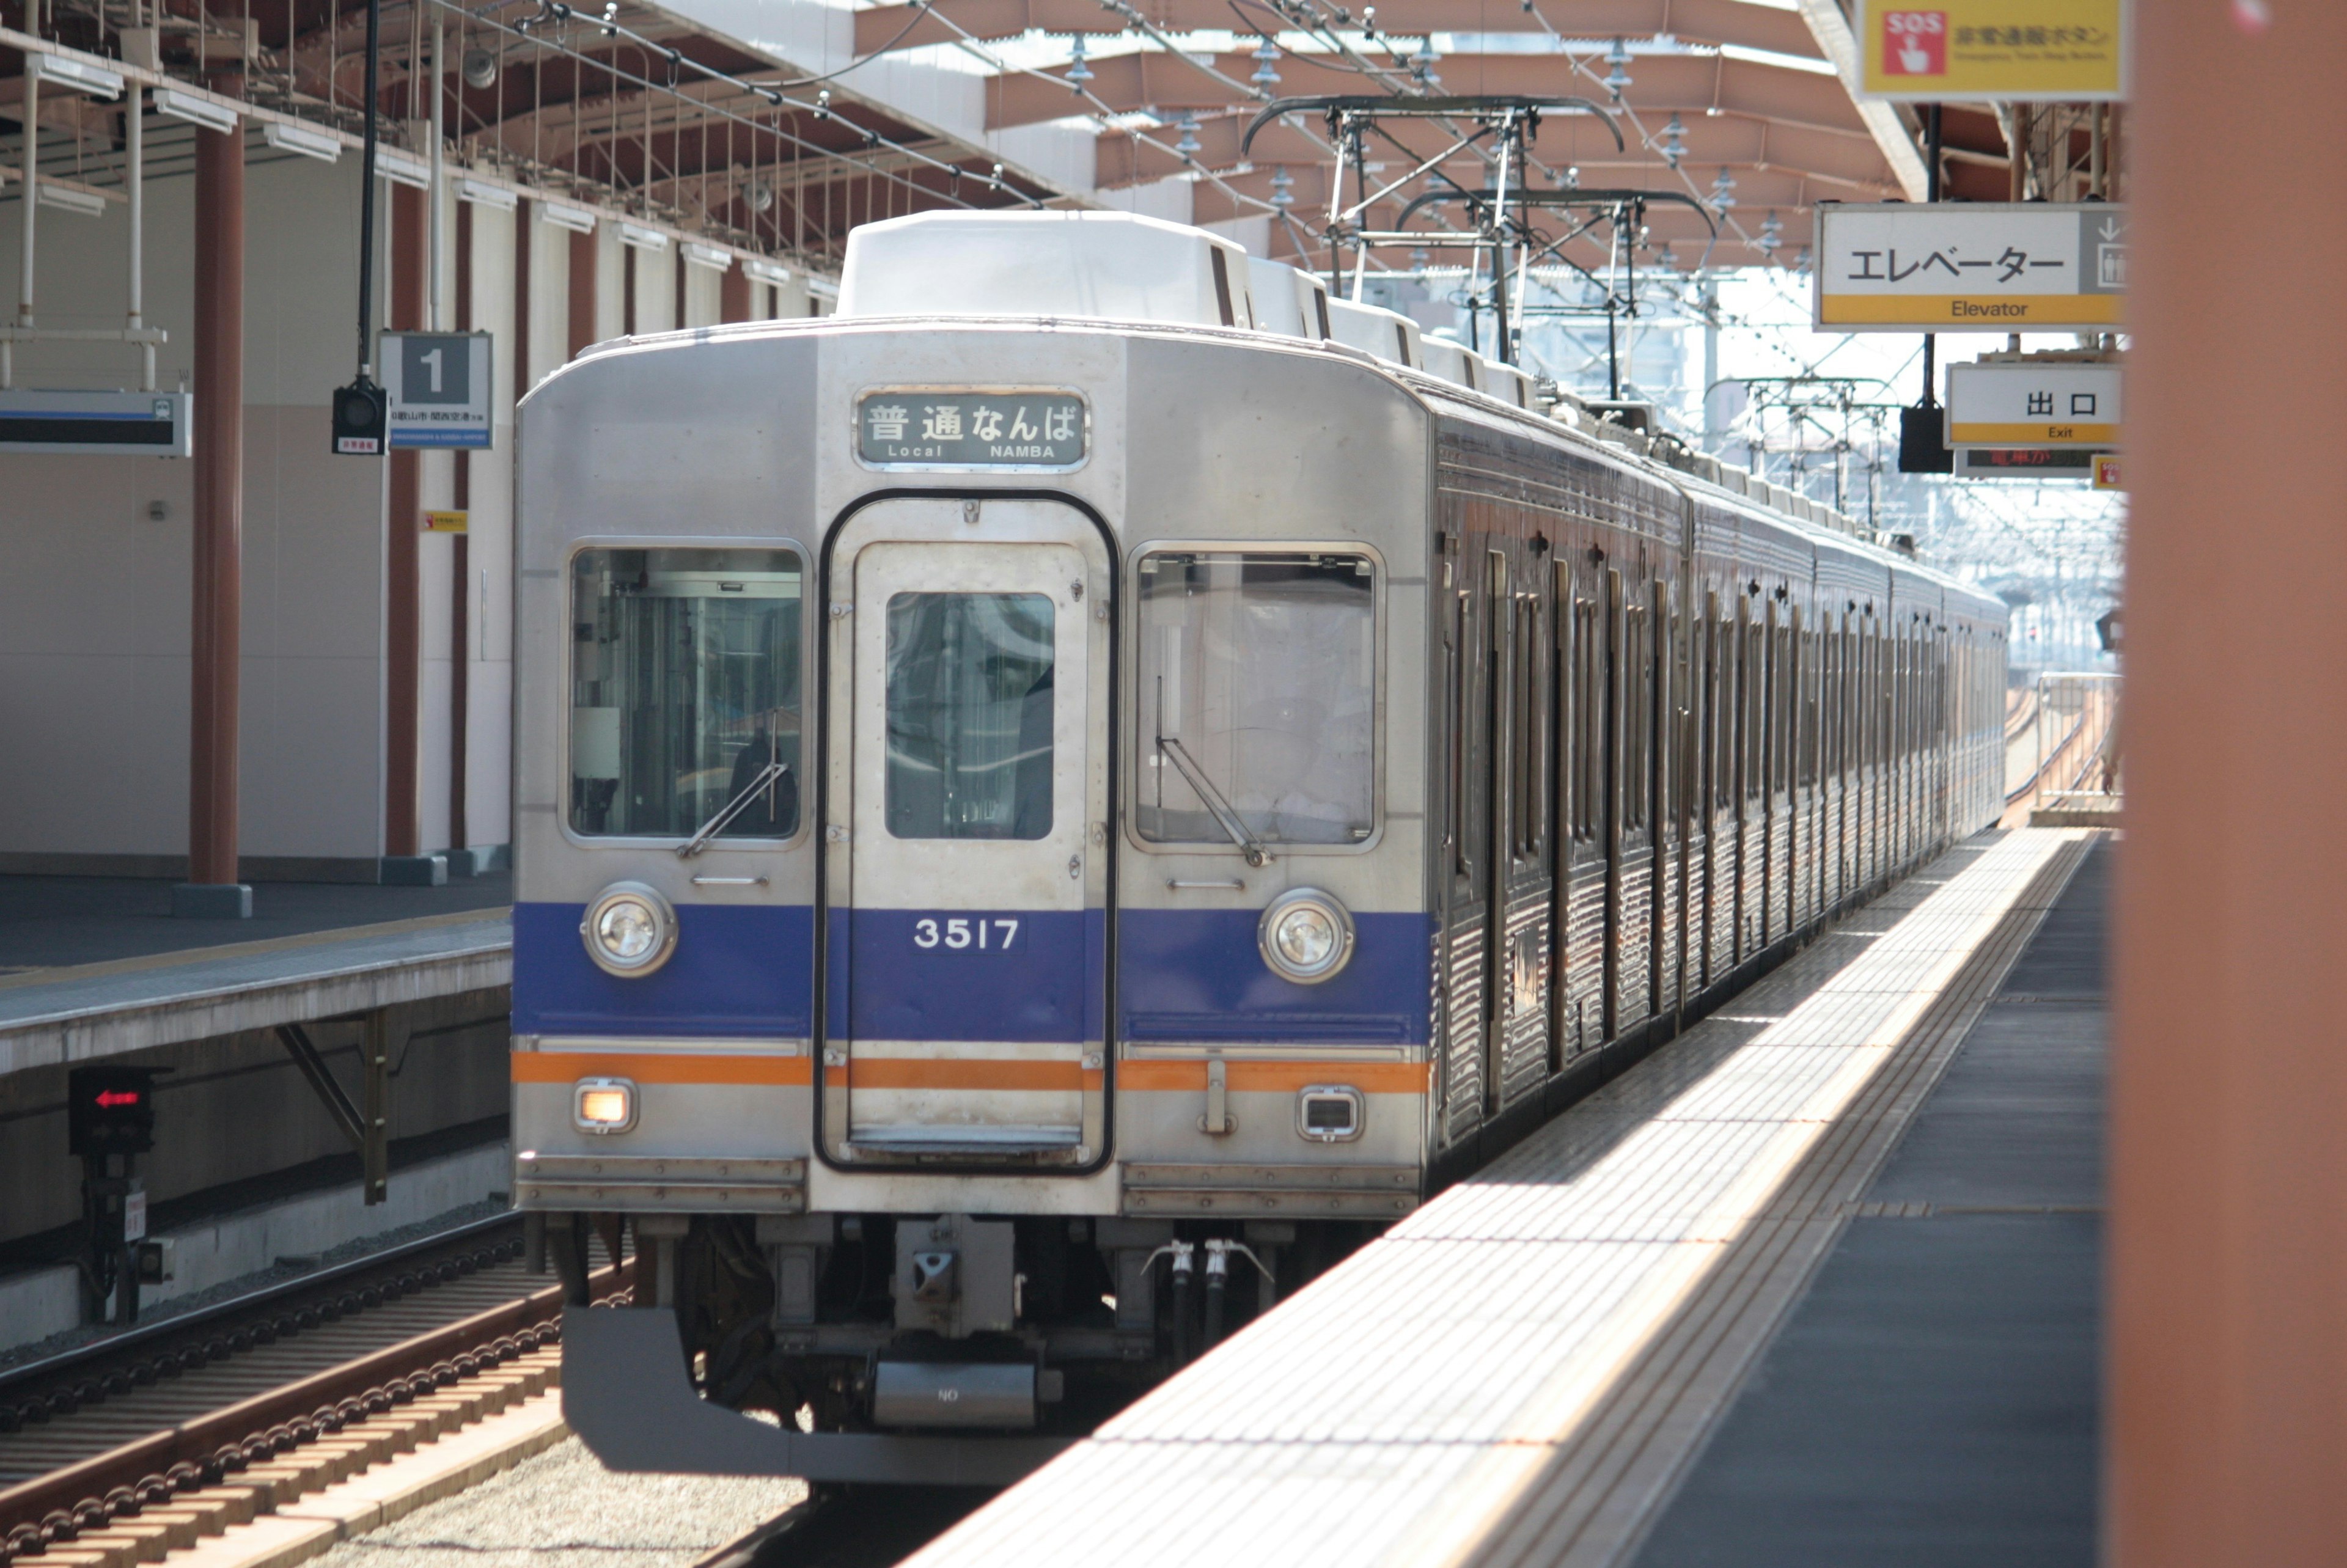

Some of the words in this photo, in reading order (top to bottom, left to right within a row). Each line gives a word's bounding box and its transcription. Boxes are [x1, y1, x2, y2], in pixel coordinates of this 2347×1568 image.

[1887, 12, 1943, 34] SOS
[1847, 245, 2065, 284] エレベーター
[1951, 300, 2029, 317] Elevator
[420, 348, 442, 392] 1
[2027, 391, 2096, 416] 出口
[867, 405, 964, 441] 普通
[972, 405, 1077, 441] なんば
[2048, 427, 2073, 438] Exit
[888, 445, 942, 458] Local
[990, 445, 1054, 458] NAMBA
[913, 918, 1019, 950] 3517
